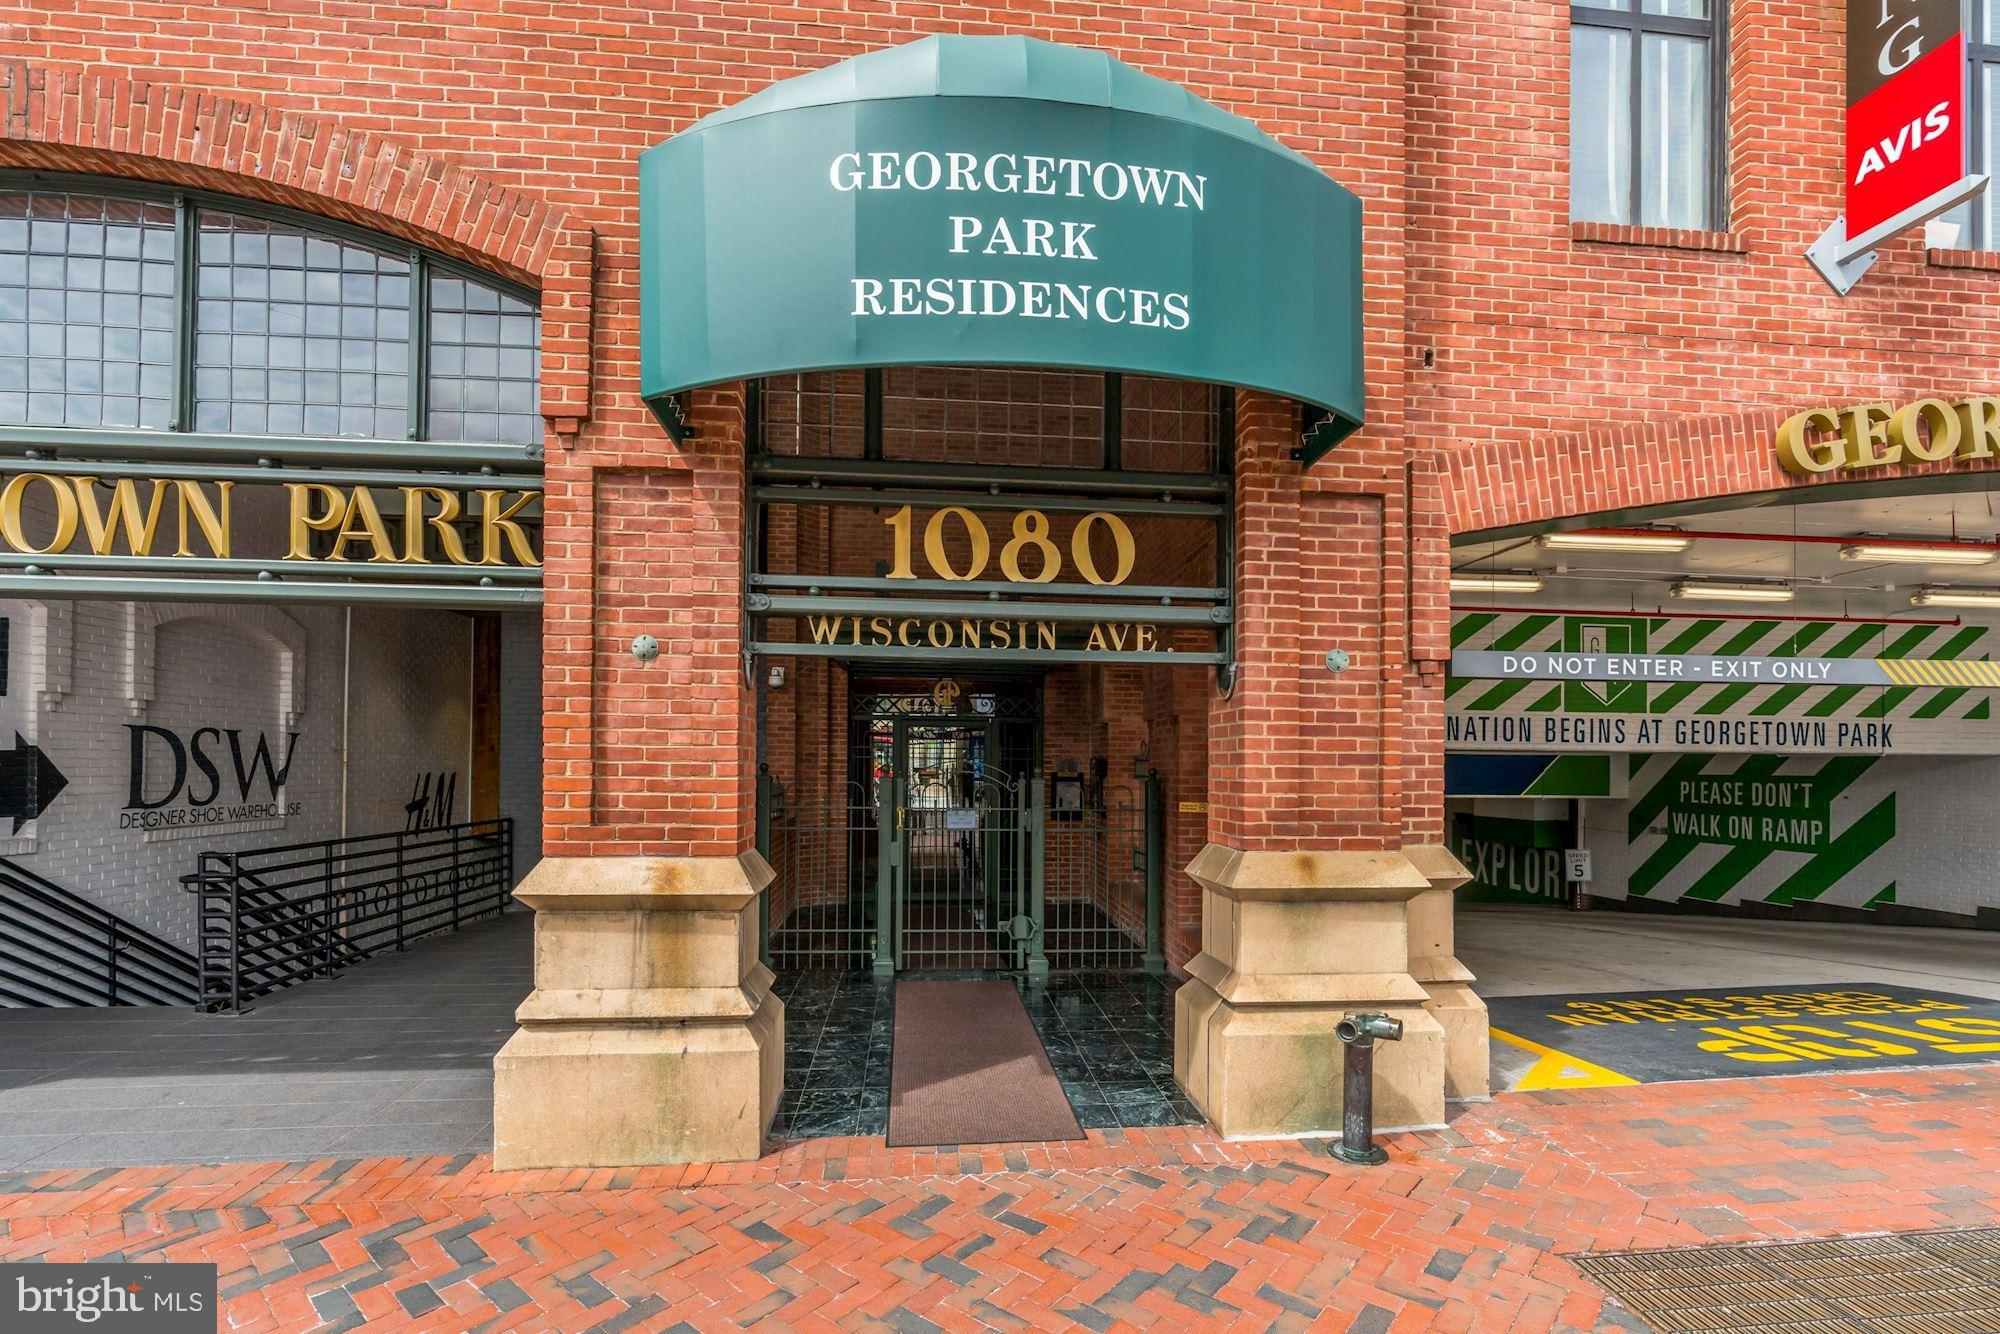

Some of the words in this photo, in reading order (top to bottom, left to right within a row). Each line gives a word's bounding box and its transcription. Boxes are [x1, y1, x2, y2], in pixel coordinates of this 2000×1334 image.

[1854, 101, 1950, 186] AVIS
[829, 151, 1208, 211] GEORGETOWN
[948, 215, 1098, 261] PARK
[850, 277, 1190, 330] RESIDENCES
[0, 472, 235, 559] OWN
[282, 482, 545, 567] PARK
[884, 504, 1136, 586] 1080
[806, 615, 1058, 651] WISCONSIN
[1084, 622, 1175, 654] AVE.
[1502, 656, 1538, 675] DO
[1548, 657, 1597, 676] NOT
[1607, 658, 1684, 677] ENTER
[1711, 659, 1765, 679] EXIT
[1773, 661, 1832, 680] ONLY
[1544, 717, 1626, 744] BEGINS
[1638, 719, 1663, 744] AT
[1675, 720, 1827, 748] GEORGETOWN
[1838, 722, 1894, 748] PARK
[122, 724, 301, 810] DSW
[404, 771, 457, 838] H&M
[1680, 781, 1744, 806] PLEASE
[1752, 782, 1814, 809] DON'T
[189, 807, 225, 824] SHOE
[1672, 812, 1722, 838] WALK
[1728, 815, 1753, 840] ON
[1762, 817, 1824, 846] RAMP
[1574, 864, 1584, 877] 5
[1546, 999, 1972, 1026] PEDESTRIAN
[1566, 991, 1893, 1013] CROSSING
